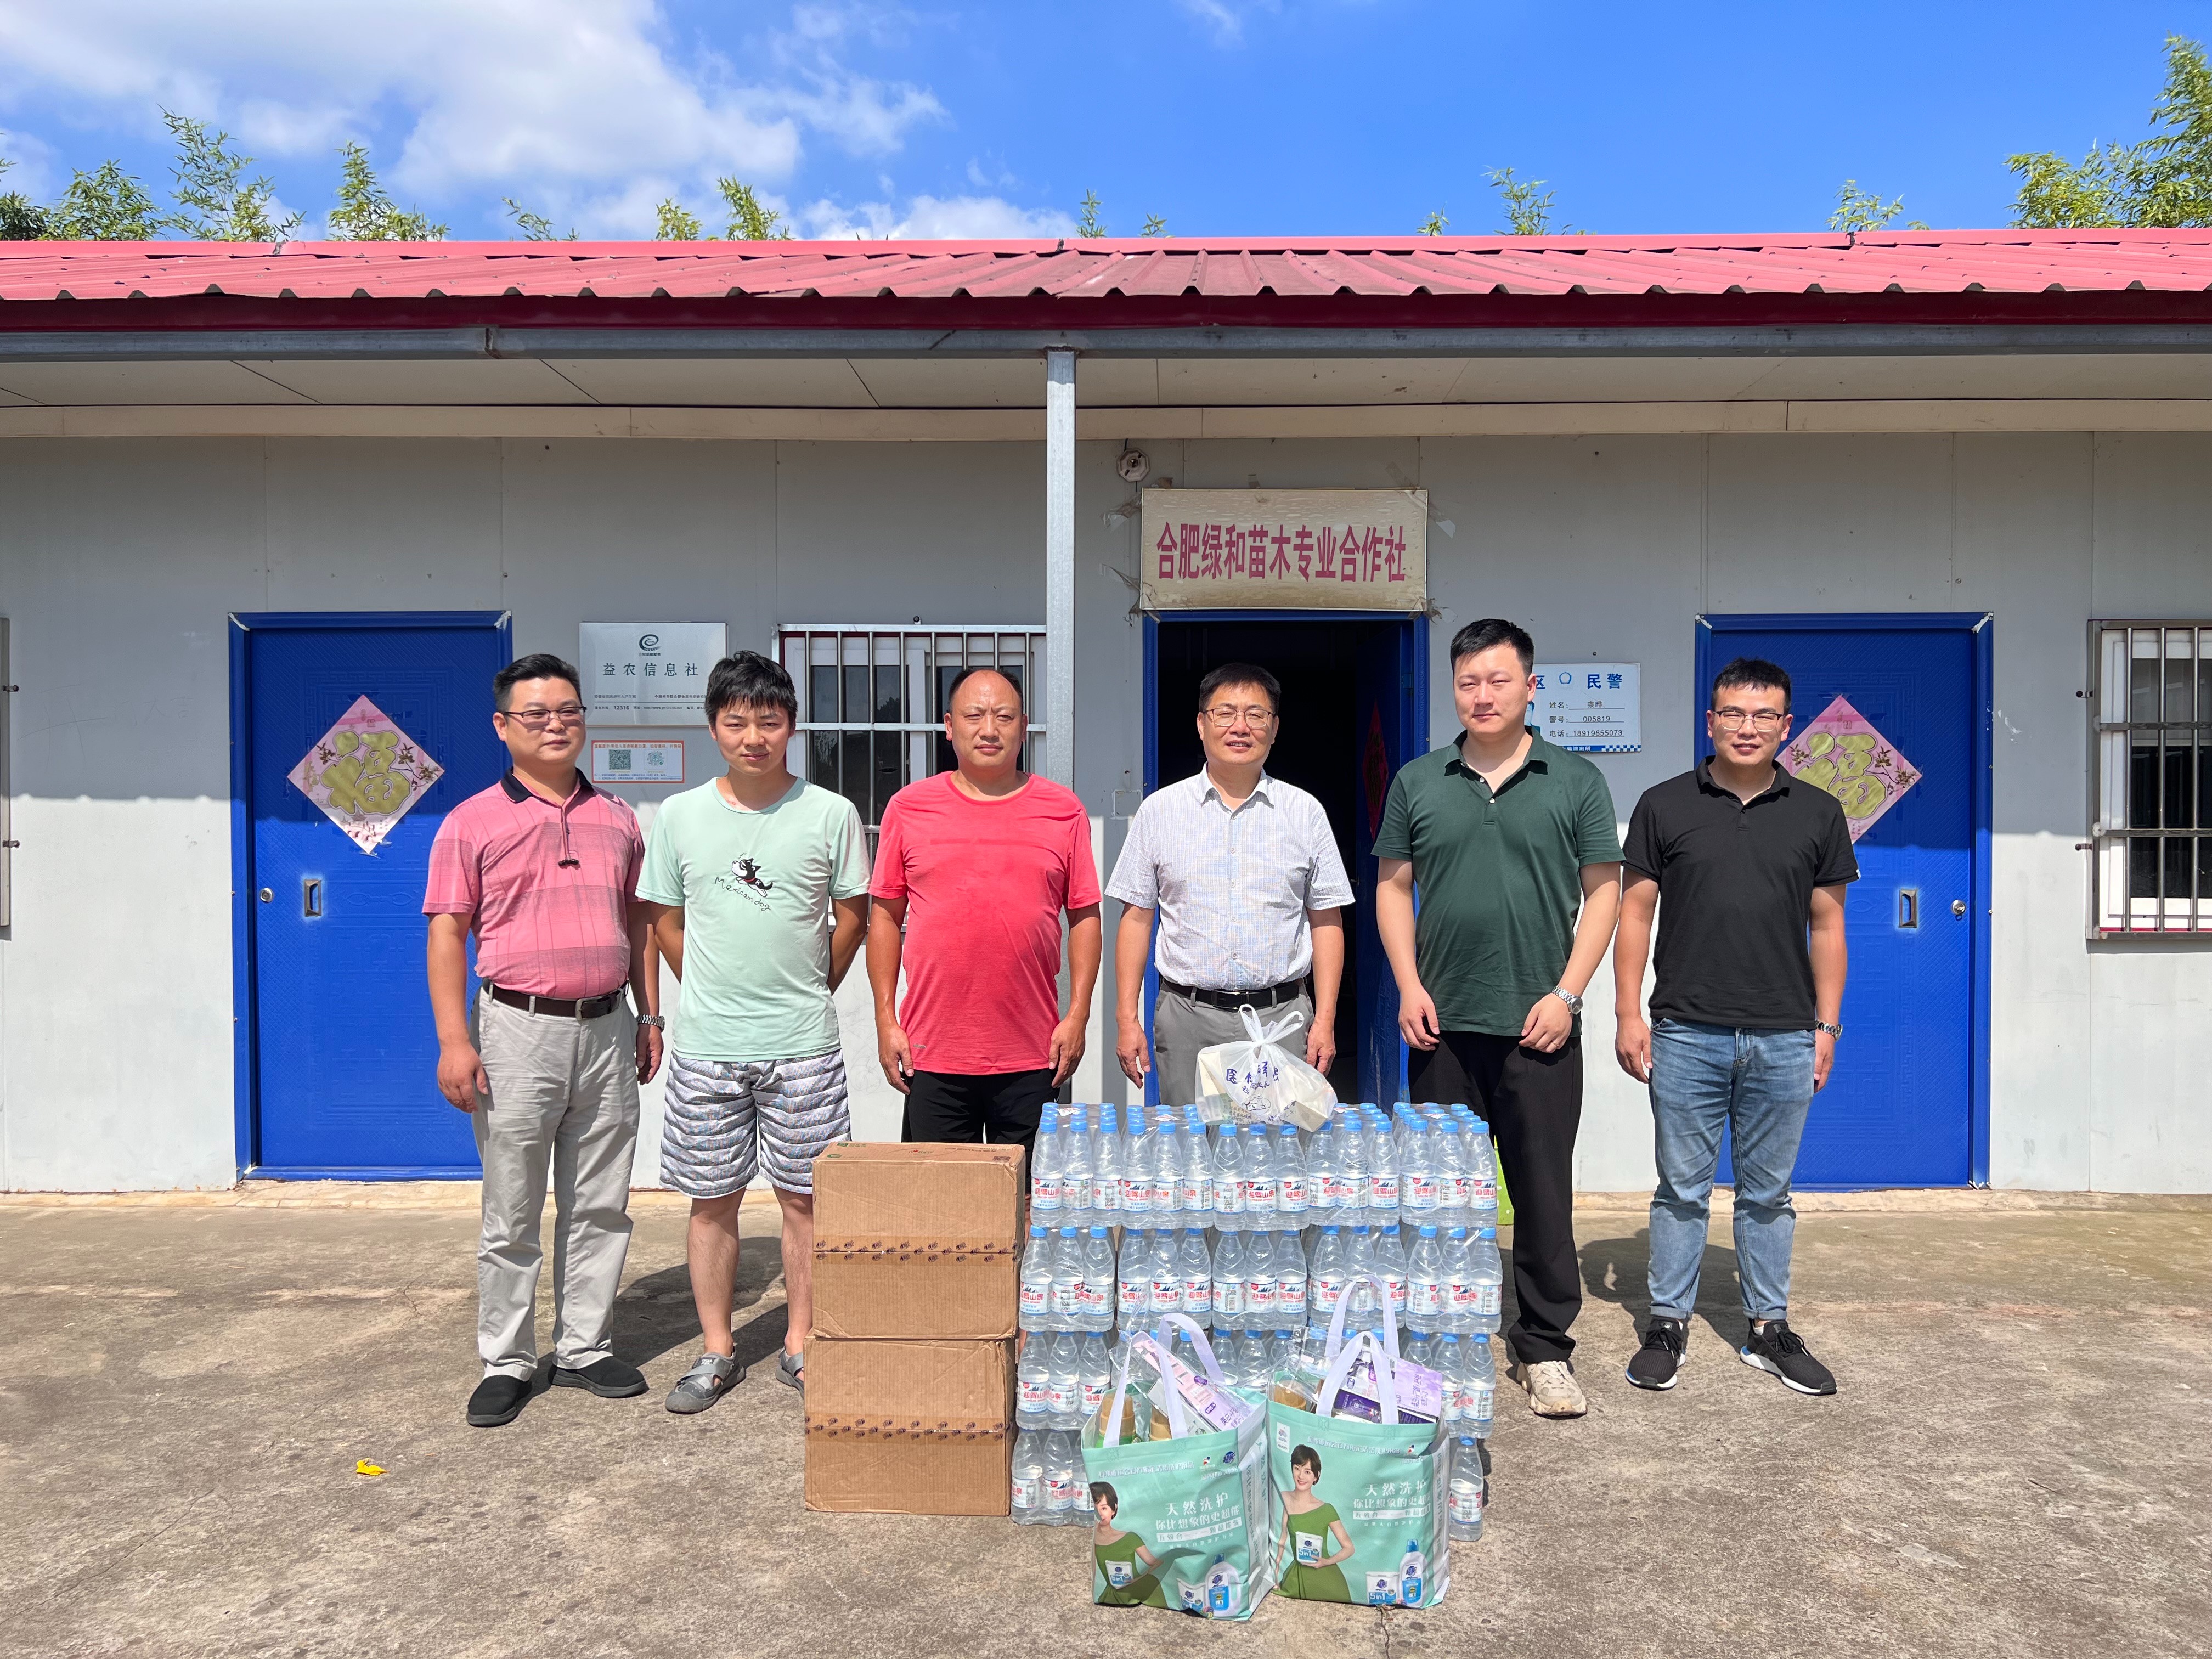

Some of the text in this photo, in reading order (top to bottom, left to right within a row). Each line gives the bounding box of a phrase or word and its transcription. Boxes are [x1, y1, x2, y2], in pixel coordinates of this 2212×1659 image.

[1156, 522, 1407, 582] 合肥绿和苗木专业合作社
[603, 662, 698, 677] 益农信息社
[1587, 673, 1622, 689] 民警
[321, 730, 412, 814] 福
[715, 876, 771, 911] Mexican dog
[1364, 1479, 1426, 1497] 天然洗护
[1165, 1492, 1228, 1516] 天然洗护
[1156, 1505, 1240, 1530] 你比想象的更超能
[1299, 1548, 1311, 1556] 5in1
[1369, 1592, 1385, 1600] 5in1
